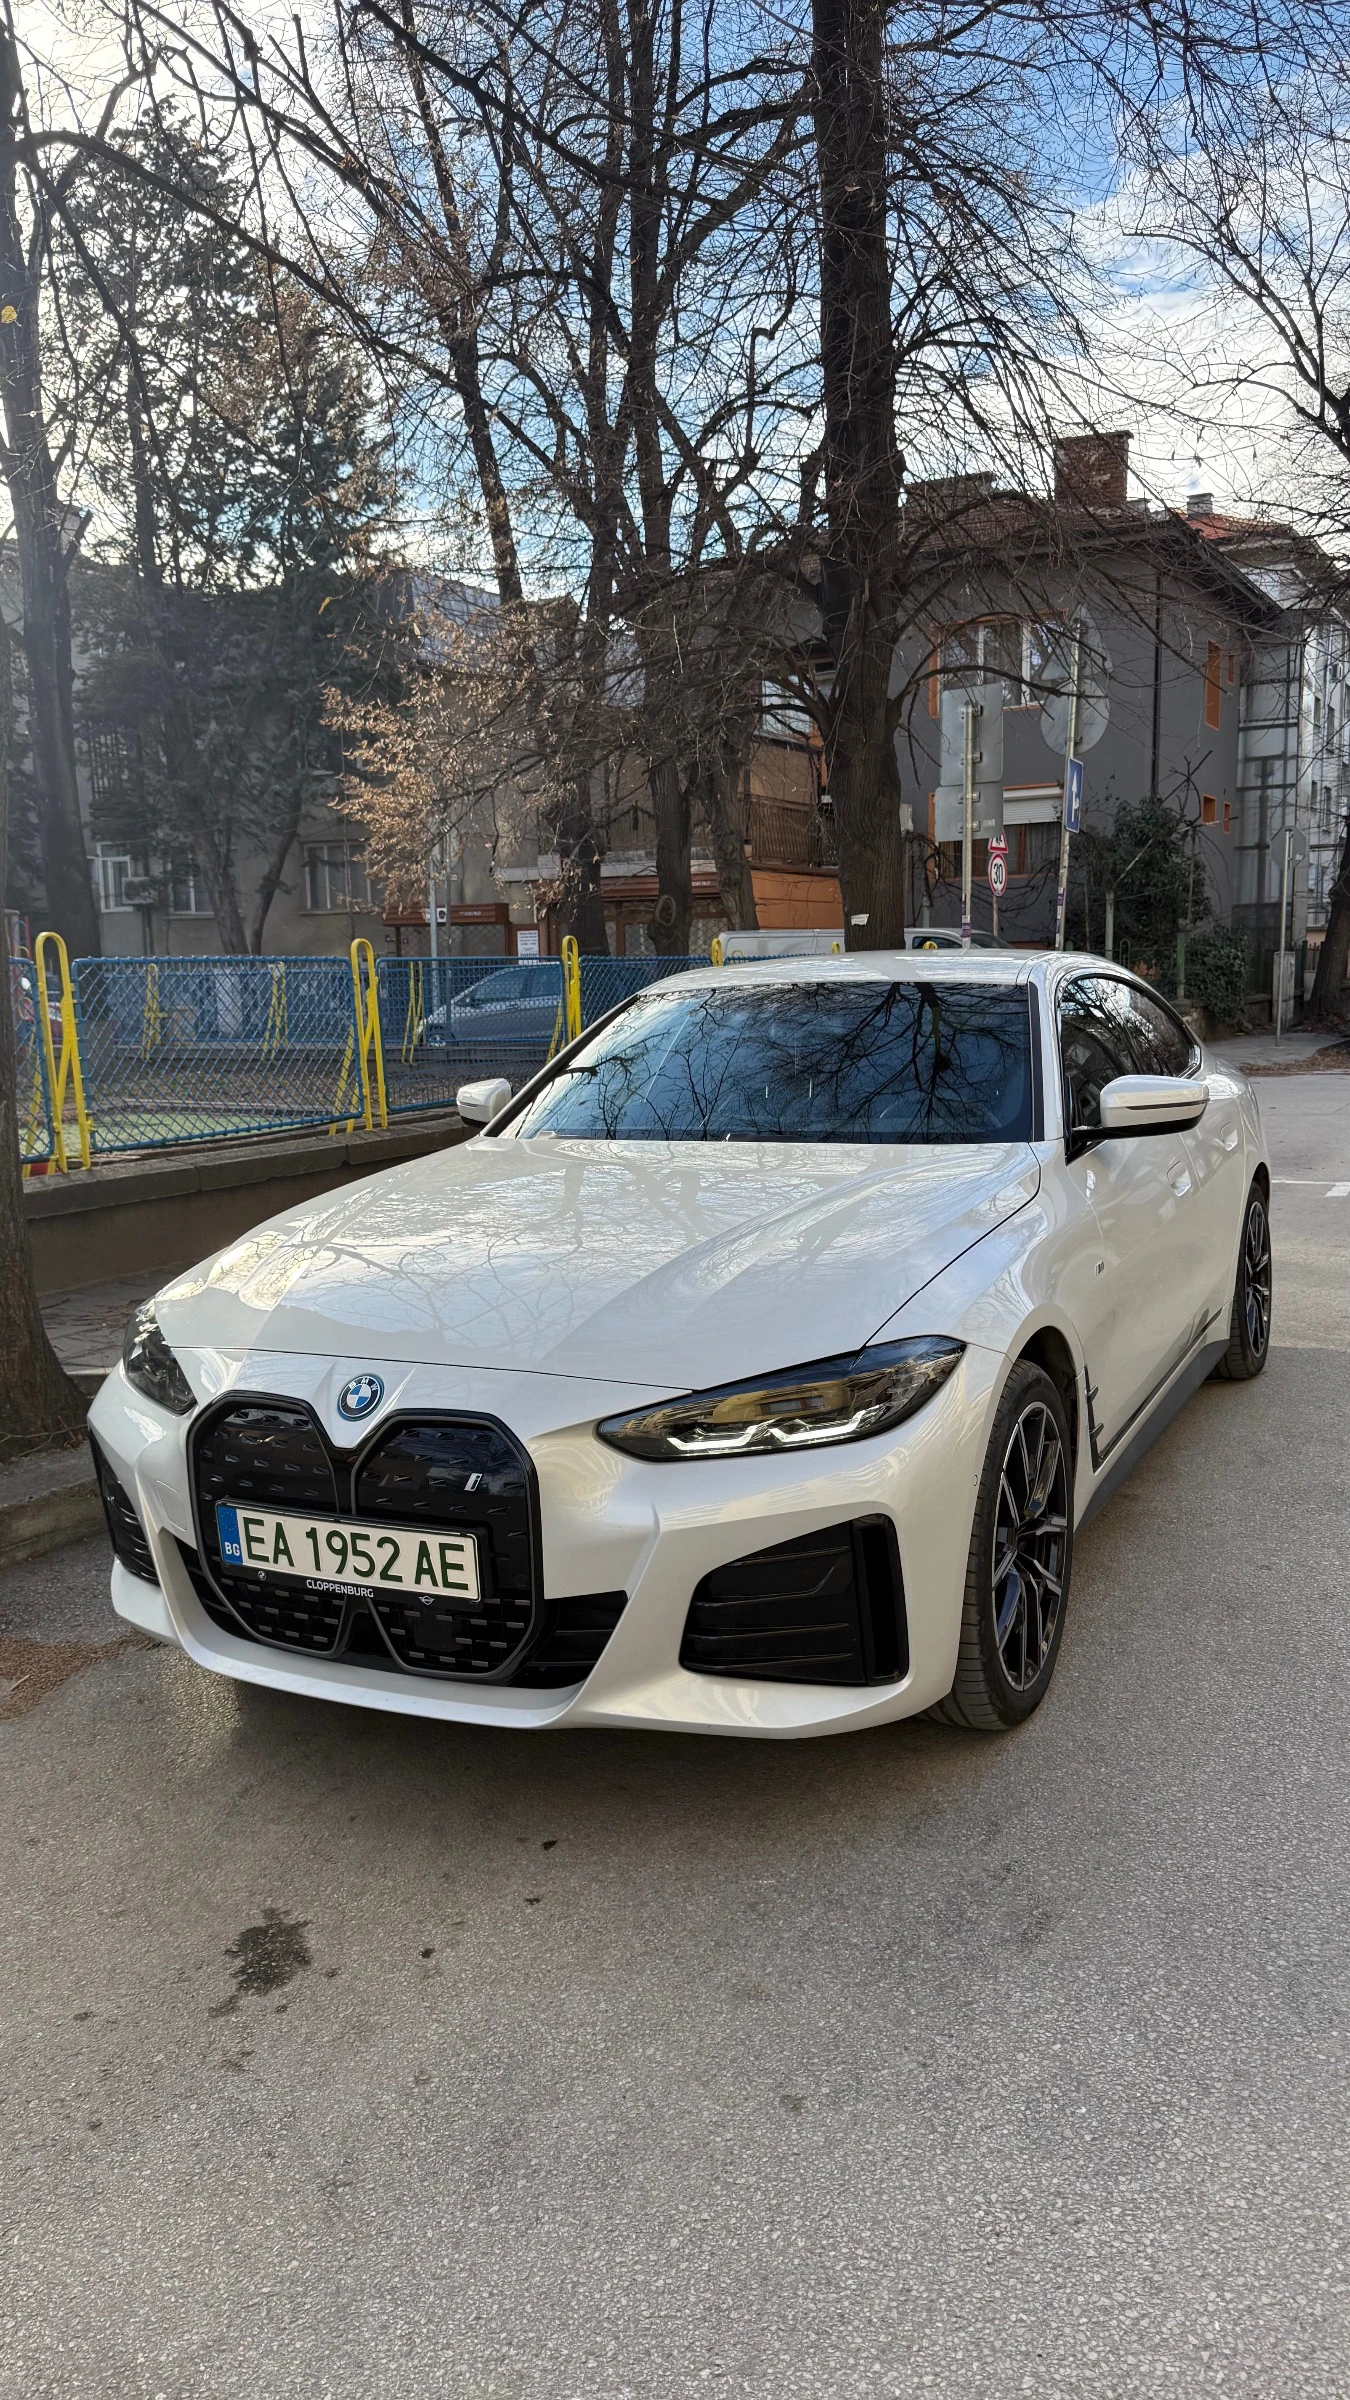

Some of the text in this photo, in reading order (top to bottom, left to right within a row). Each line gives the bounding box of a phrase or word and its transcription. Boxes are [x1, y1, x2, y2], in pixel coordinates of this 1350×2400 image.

[993, 863, 1004, 885] 30
[348, 1377, 379, 1391] BMW
[224, 1541, 241, 1557] BG
[243, 1516, 470, 1591] EA 1952 AE
[306, 1579, 375, 1598] CLOPPENBURG
